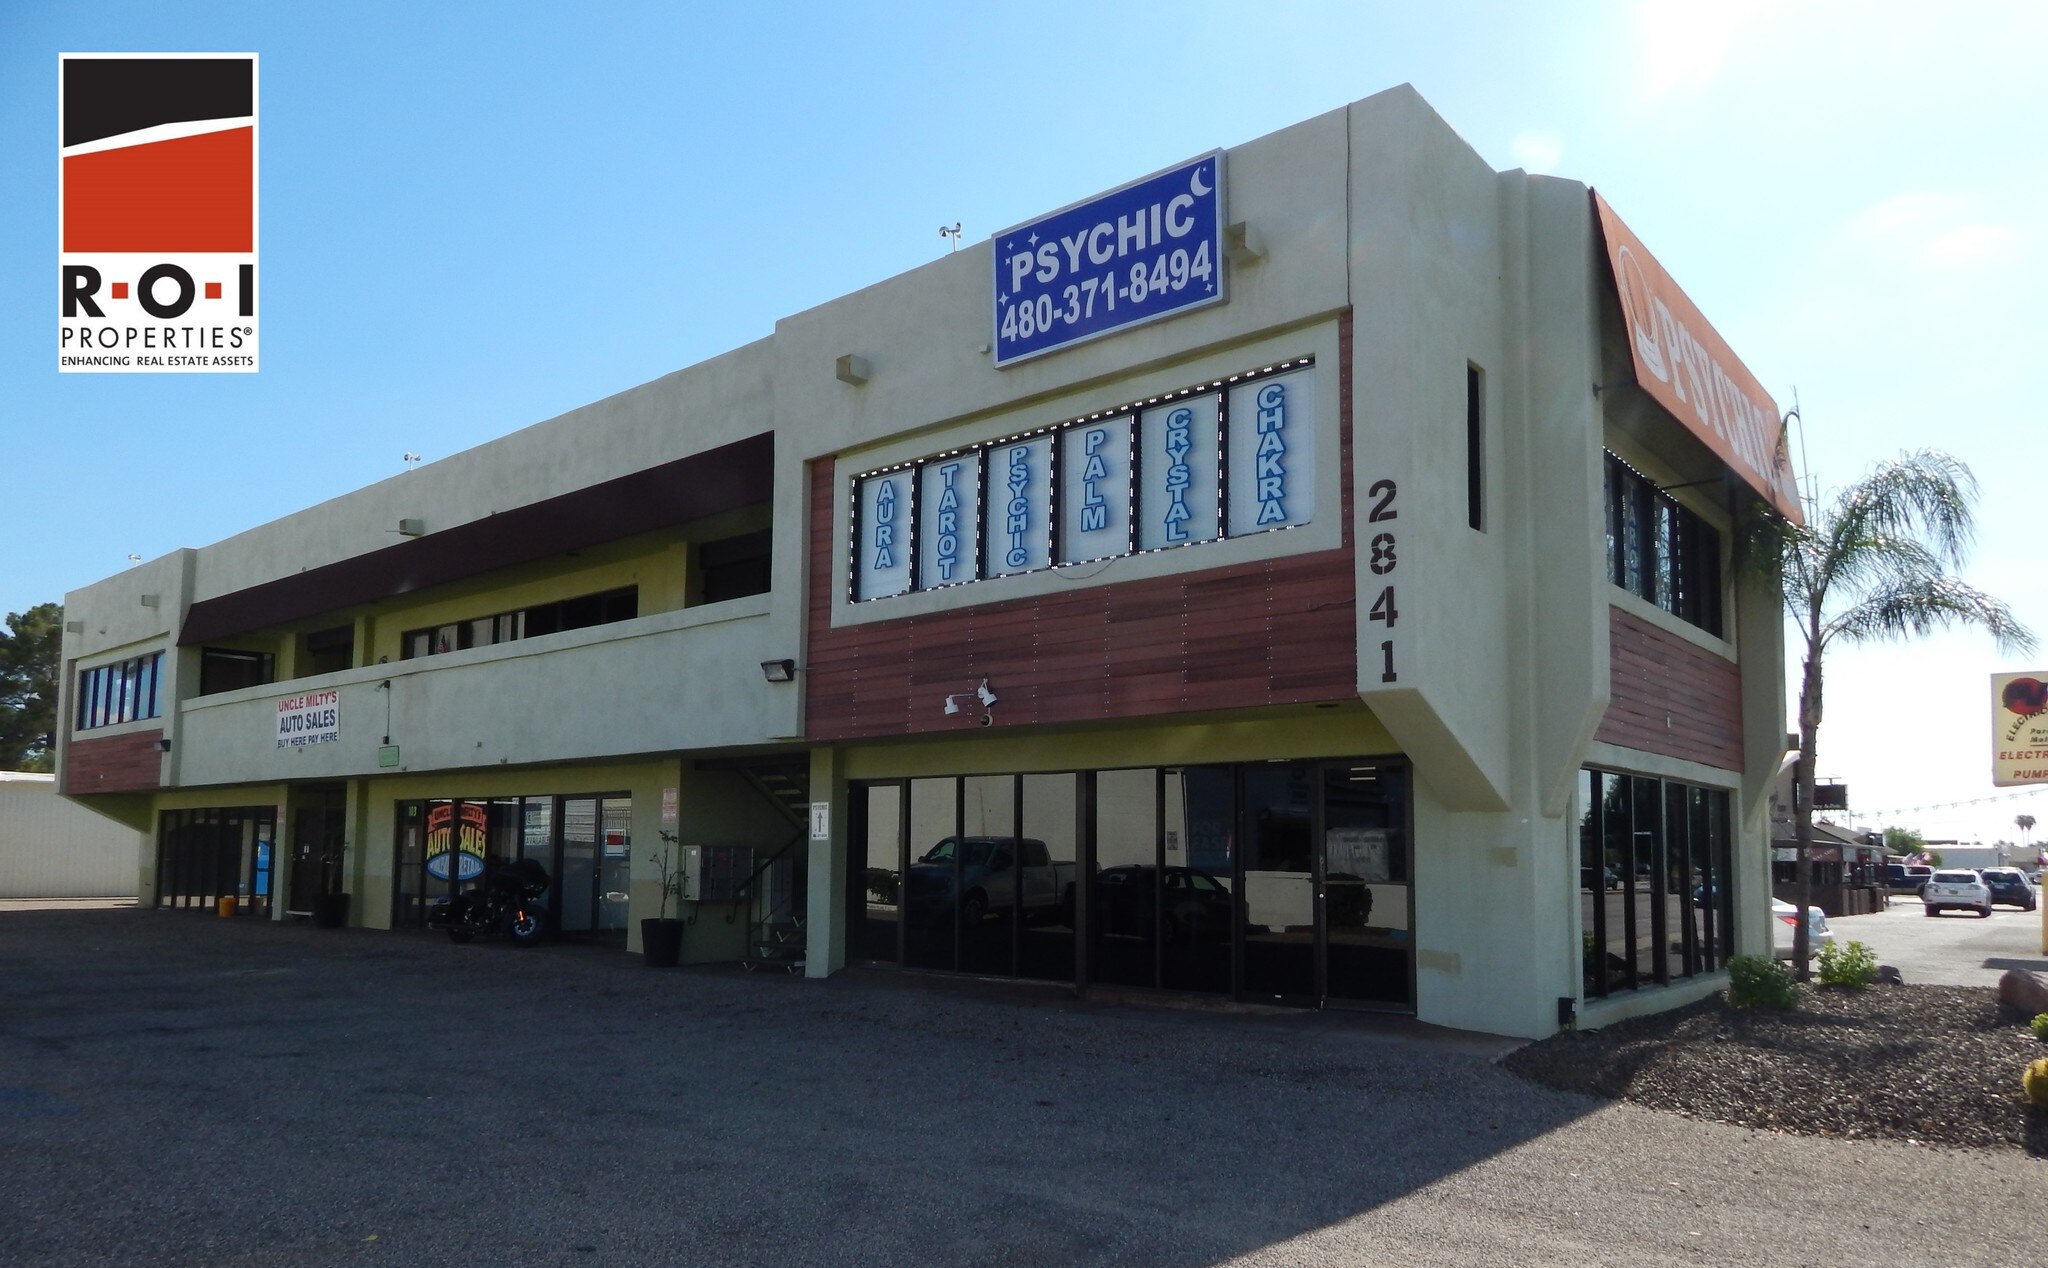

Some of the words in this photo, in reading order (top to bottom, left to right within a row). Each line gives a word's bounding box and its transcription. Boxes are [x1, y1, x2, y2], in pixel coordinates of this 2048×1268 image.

[1001, 239, 1212, 342] 480-371-8494
[1012, 193, 1195, 293] PSYCHIC
[1080, 429, 1106, 533] PALM
[1166, 408, 1191, 542] CRYSTAL
[1256, 384, 1288, 526] CHAKRA
[874, 479, 896, 571] AURA
[936, 463, 960, 580] TAROT
[1006, 446, 1029, 568] PSYCHIC
[1368, 479, 1399, 683] 2841
[277, 738, 289, 748] BUY
[290, 736, 306, 746] HERE
[307, 734, 319, 745] PAY
[320, 731, 338, 742] HERE
[278, 697, 304, 712] UNCLE
[305, 690, 337, 708] MILTY'S
[280, 714, 303, 734] AUTO
[306, 709, 336, 730] SALES
